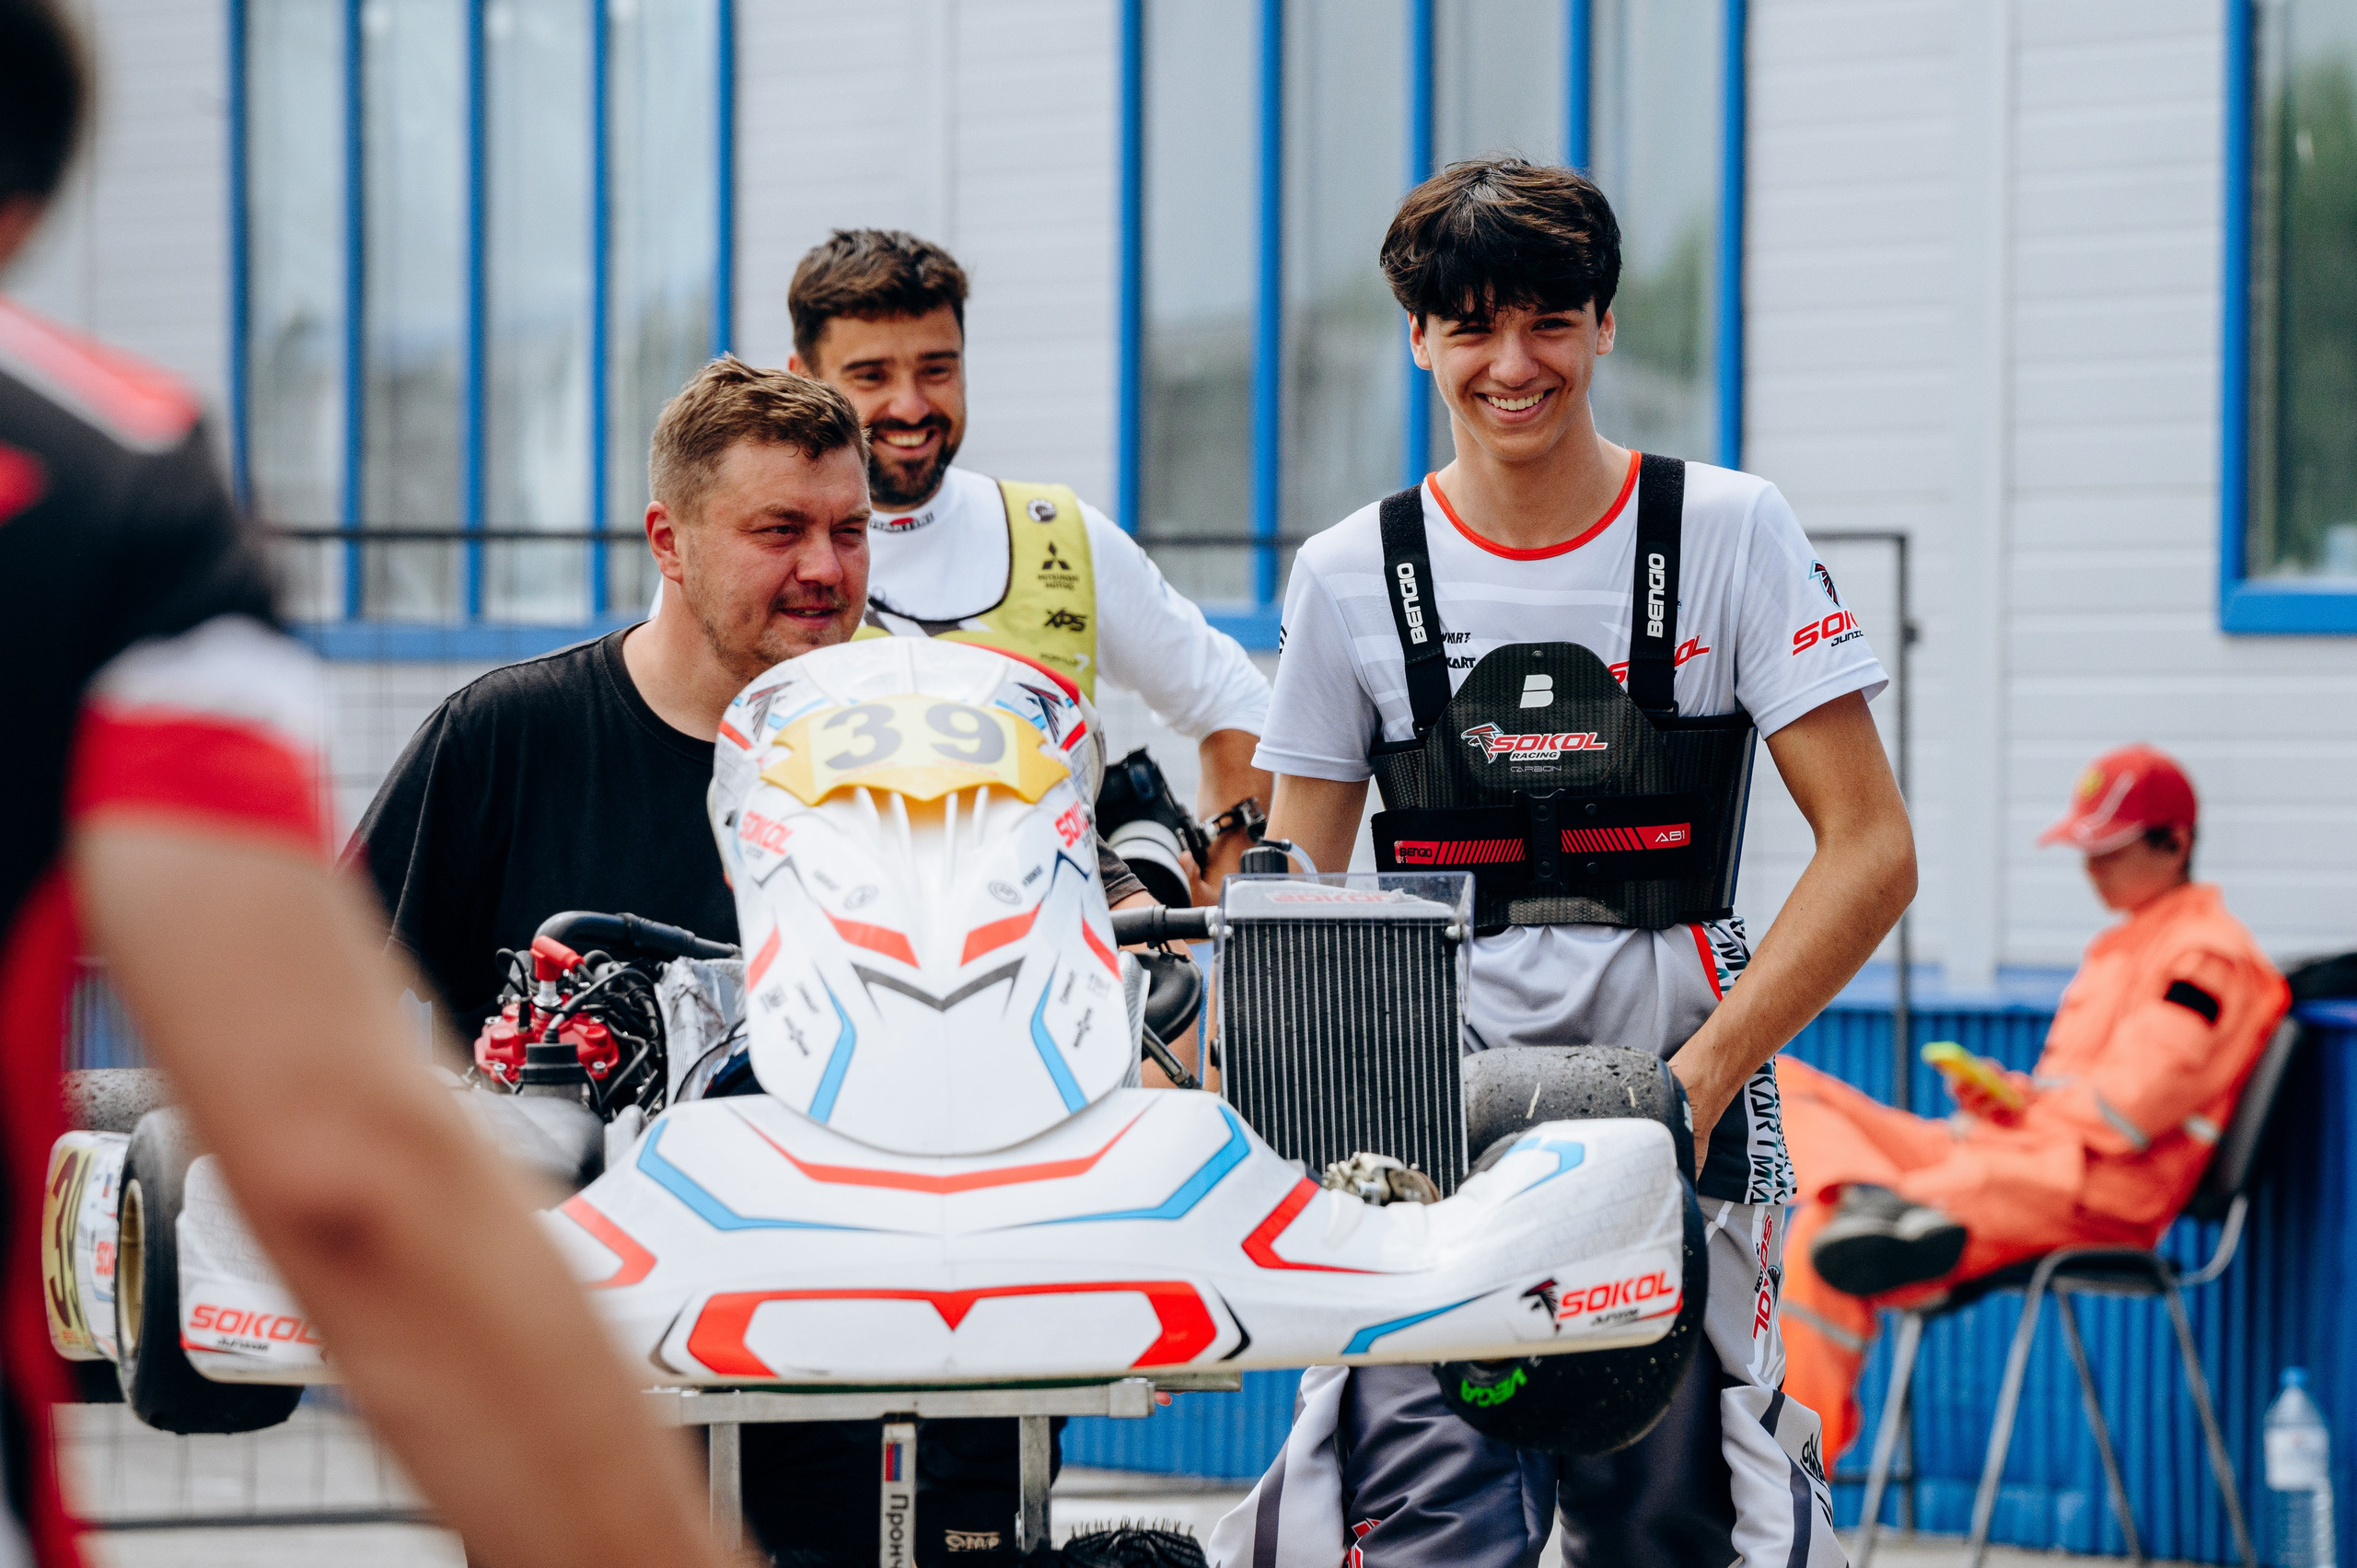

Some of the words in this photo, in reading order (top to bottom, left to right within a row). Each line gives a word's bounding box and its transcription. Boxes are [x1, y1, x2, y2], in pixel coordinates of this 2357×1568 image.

[1397, 563, 1428, 645] BENGIO
[1650, 552, 1665, 638] BENGIO
[1793, 610, 1859, 656] SOK
[1488, 733, 1607, 753] SOKOL
[1511, 751, 1558, 760] RACING
[1655, 830, 1686, 842] AB1
[1558, 1270, 1674, 1320] SOKOL
[1461, 1365, 1527, 1408] VEGA
